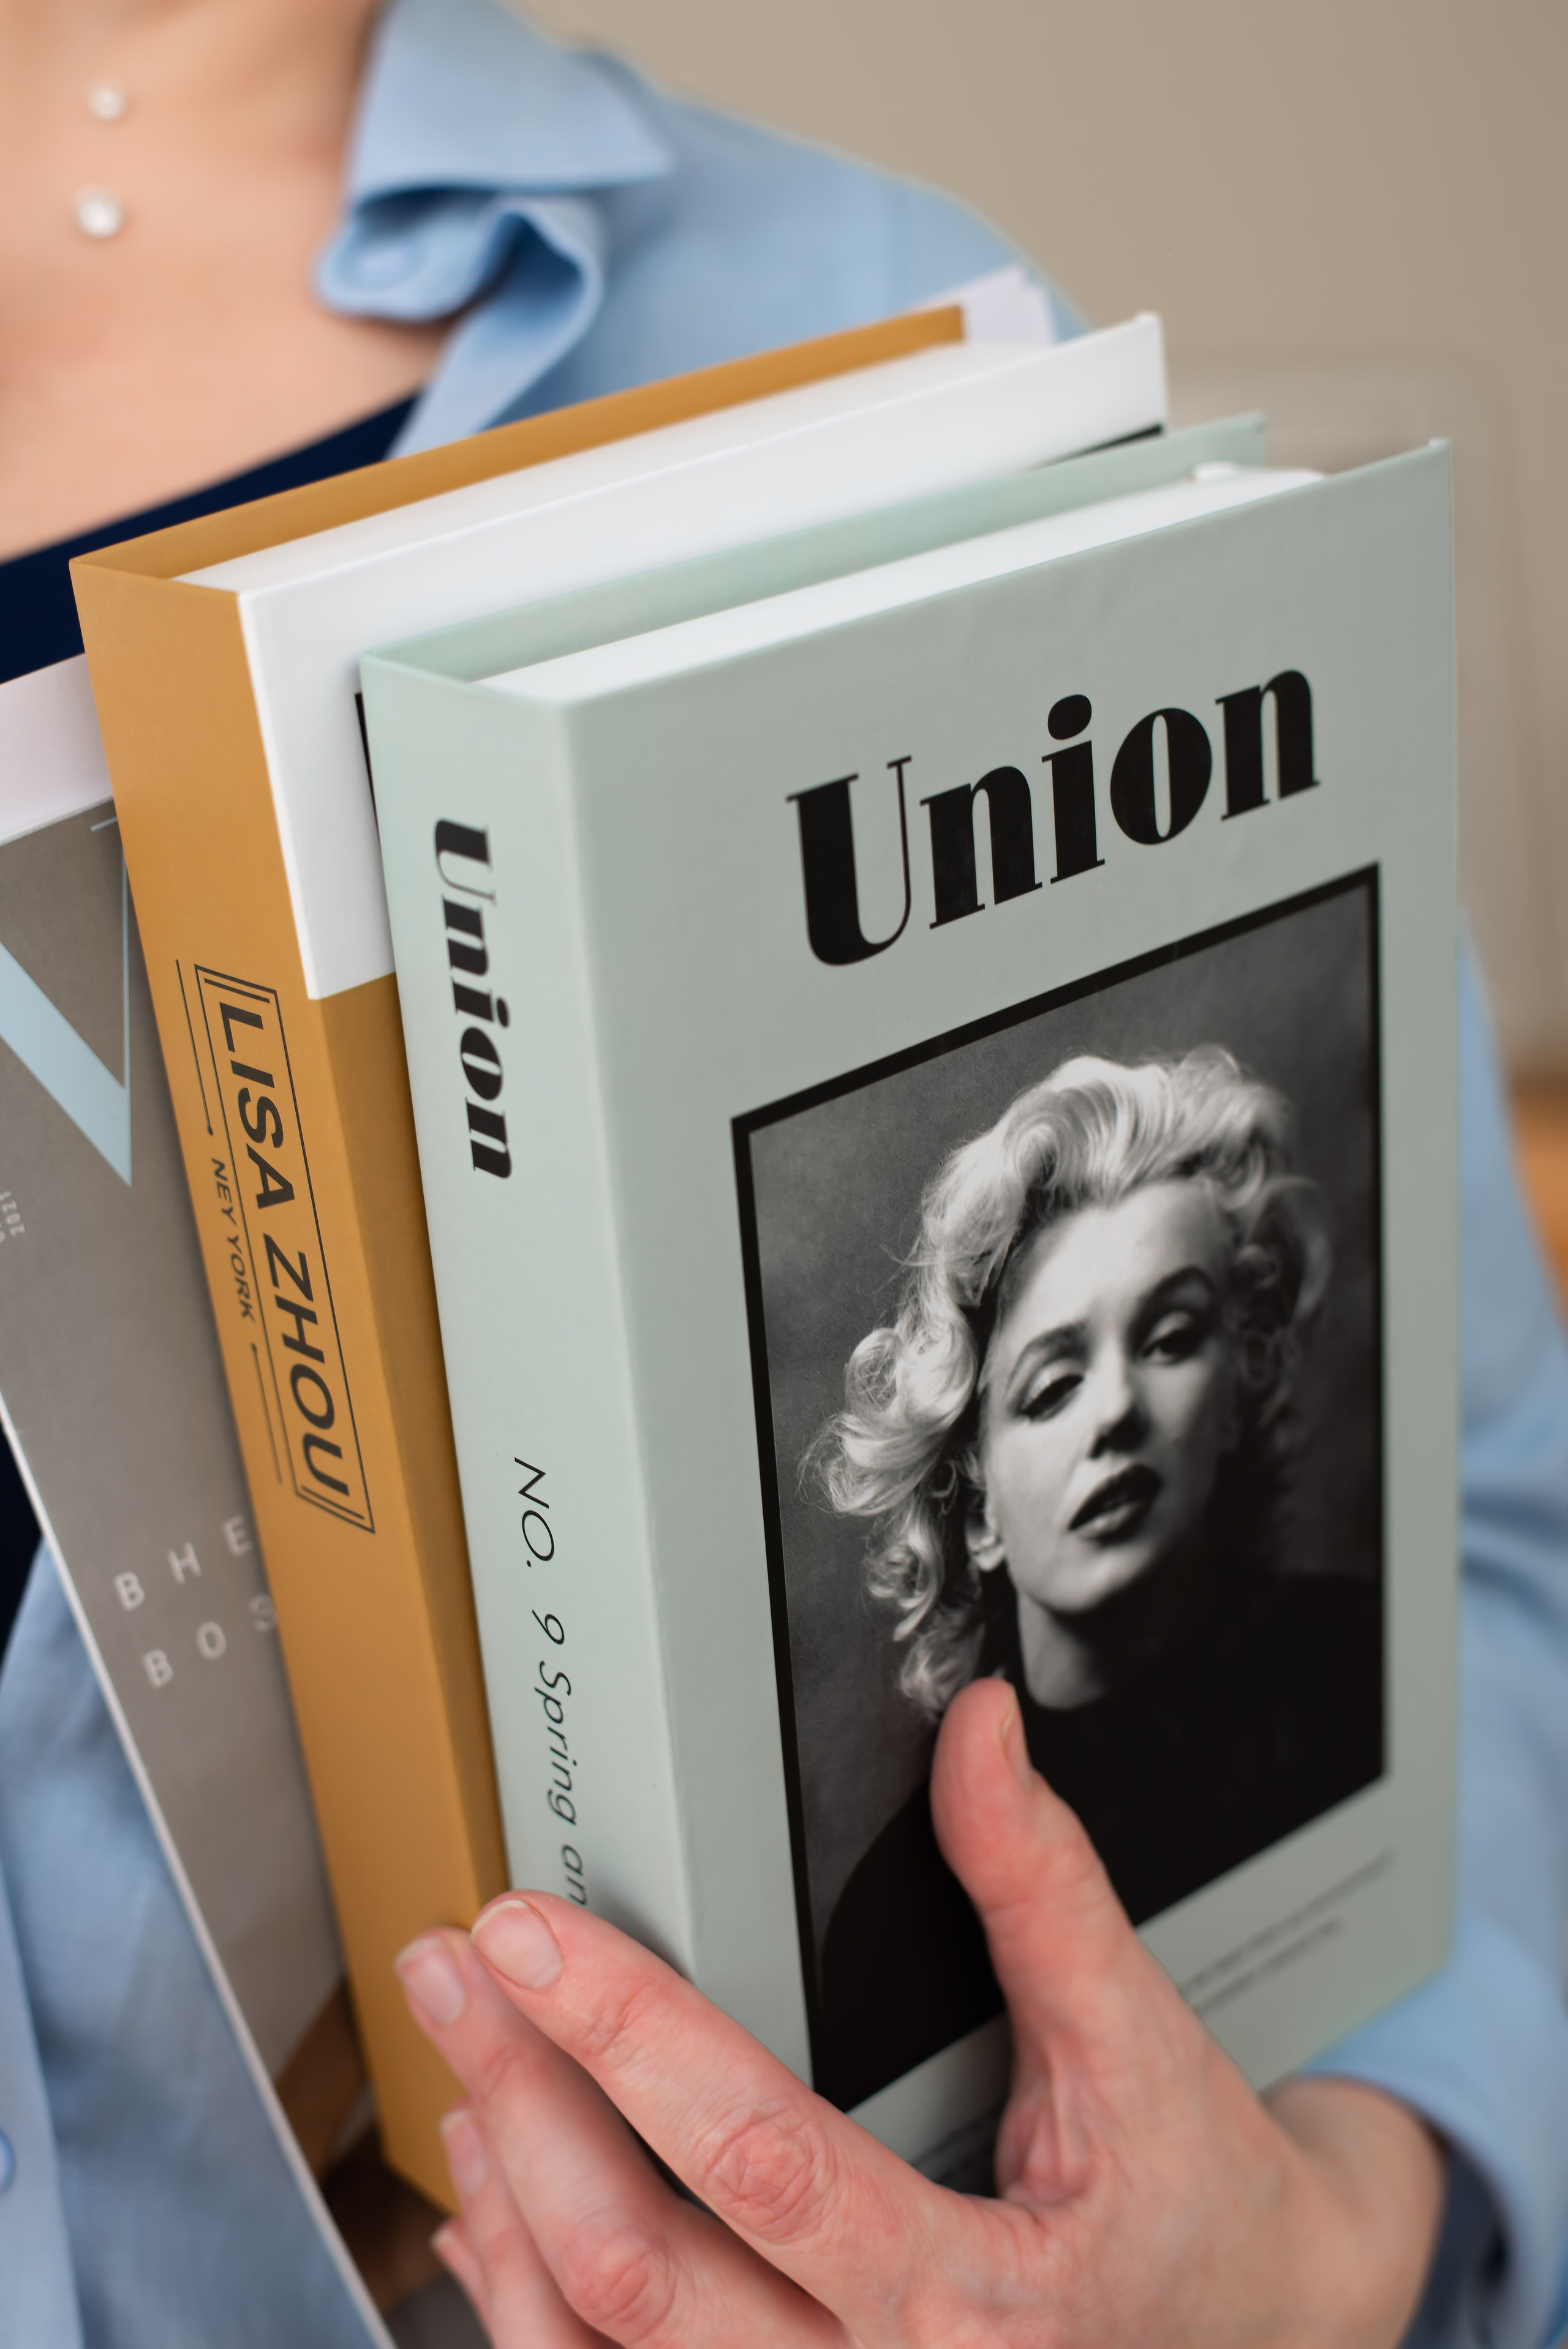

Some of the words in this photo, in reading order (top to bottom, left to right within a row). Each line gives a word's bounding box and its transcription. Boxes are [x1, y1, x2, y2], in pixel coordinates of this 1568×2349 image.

[786, 669, 1321, 966] Union
[434, 817, 513, 1179] Union
[211, 1157, 236, 1226] NEY
[226, 1234, 256, 1325] YORK
[219, 1001, 296, 1210] LISA
[263, 1232, 350, 1497] ZHOU
[514, 1456, 555, 1568] NO.
[532, 1608, 565, 1646] 9
[535, 1660, 579, 1826] Spring
[562, 1844, 587, 1905] an
